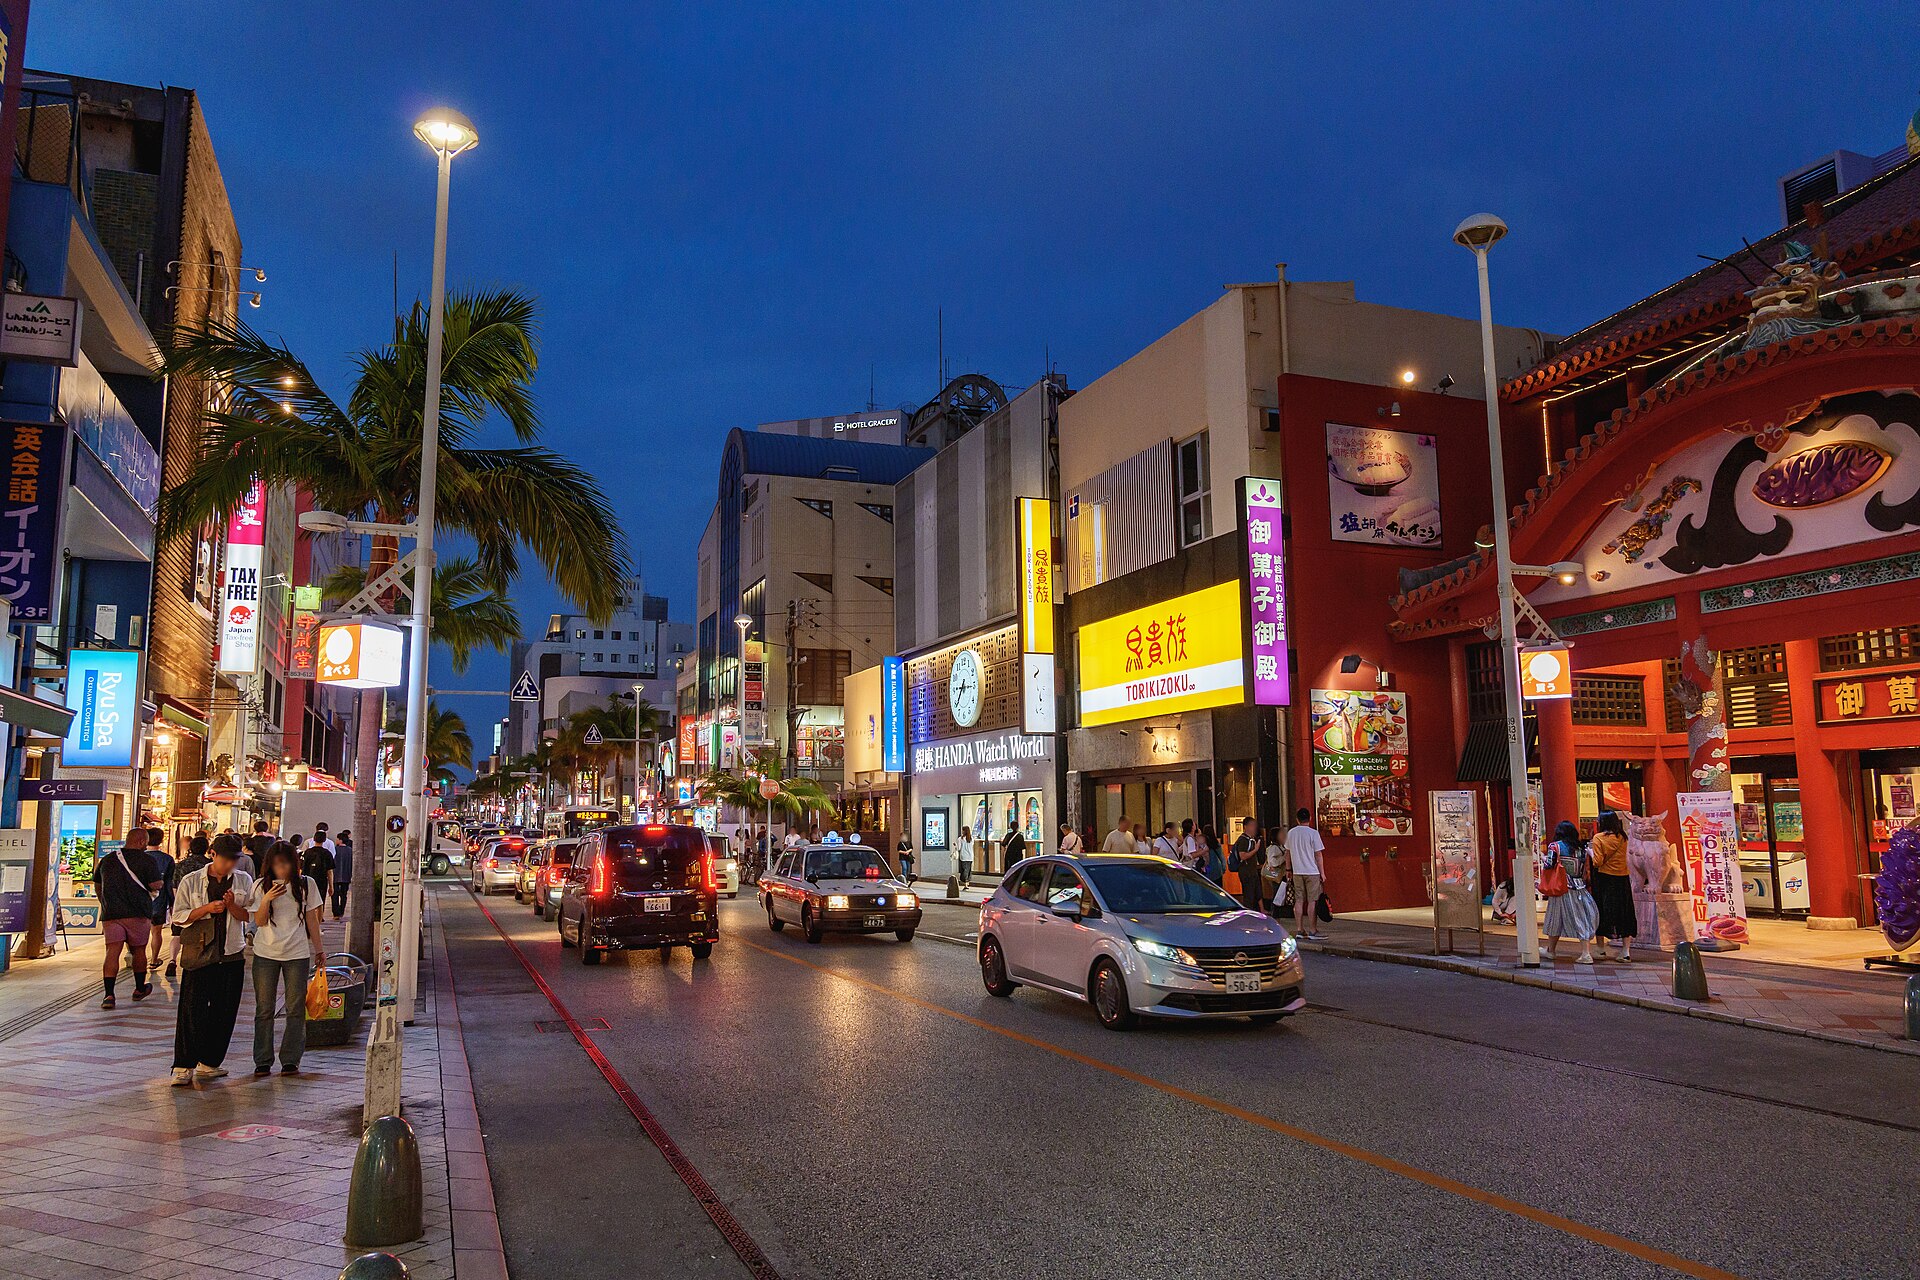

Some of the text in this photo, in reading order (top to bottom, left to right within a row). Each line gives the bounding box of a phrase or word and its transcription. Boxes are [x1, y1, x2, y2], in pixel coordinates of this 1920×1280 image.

[6, 313, 71, 326] しんれんサービス
[5, 324, 62, 336] しんれんリース
[846, 419, 898, 430] HOTEL GRACERY
[230, 567, 257, 584] TAX
[227, 584, 258, 601] FREE
[1250, 518, 1279, 682] 御菓子御殿
[234, 641, 254, 649] Shop
[1125, 674, 1188, 702] TORIKIZOKU
[1535, 682, 1556, 693] 買う
[83, 676, 94, 742] OKINAWA COSMETICS
[915, 734, 1045, 773] 銀座 HANDA Watch World
[1391, 759, 1406, 770] 2F
[56, 784, 83, 792] CIEL
[1704, 834, 1727, 903] 6年連続
[1233, 980, 1259, 992] 50-63
